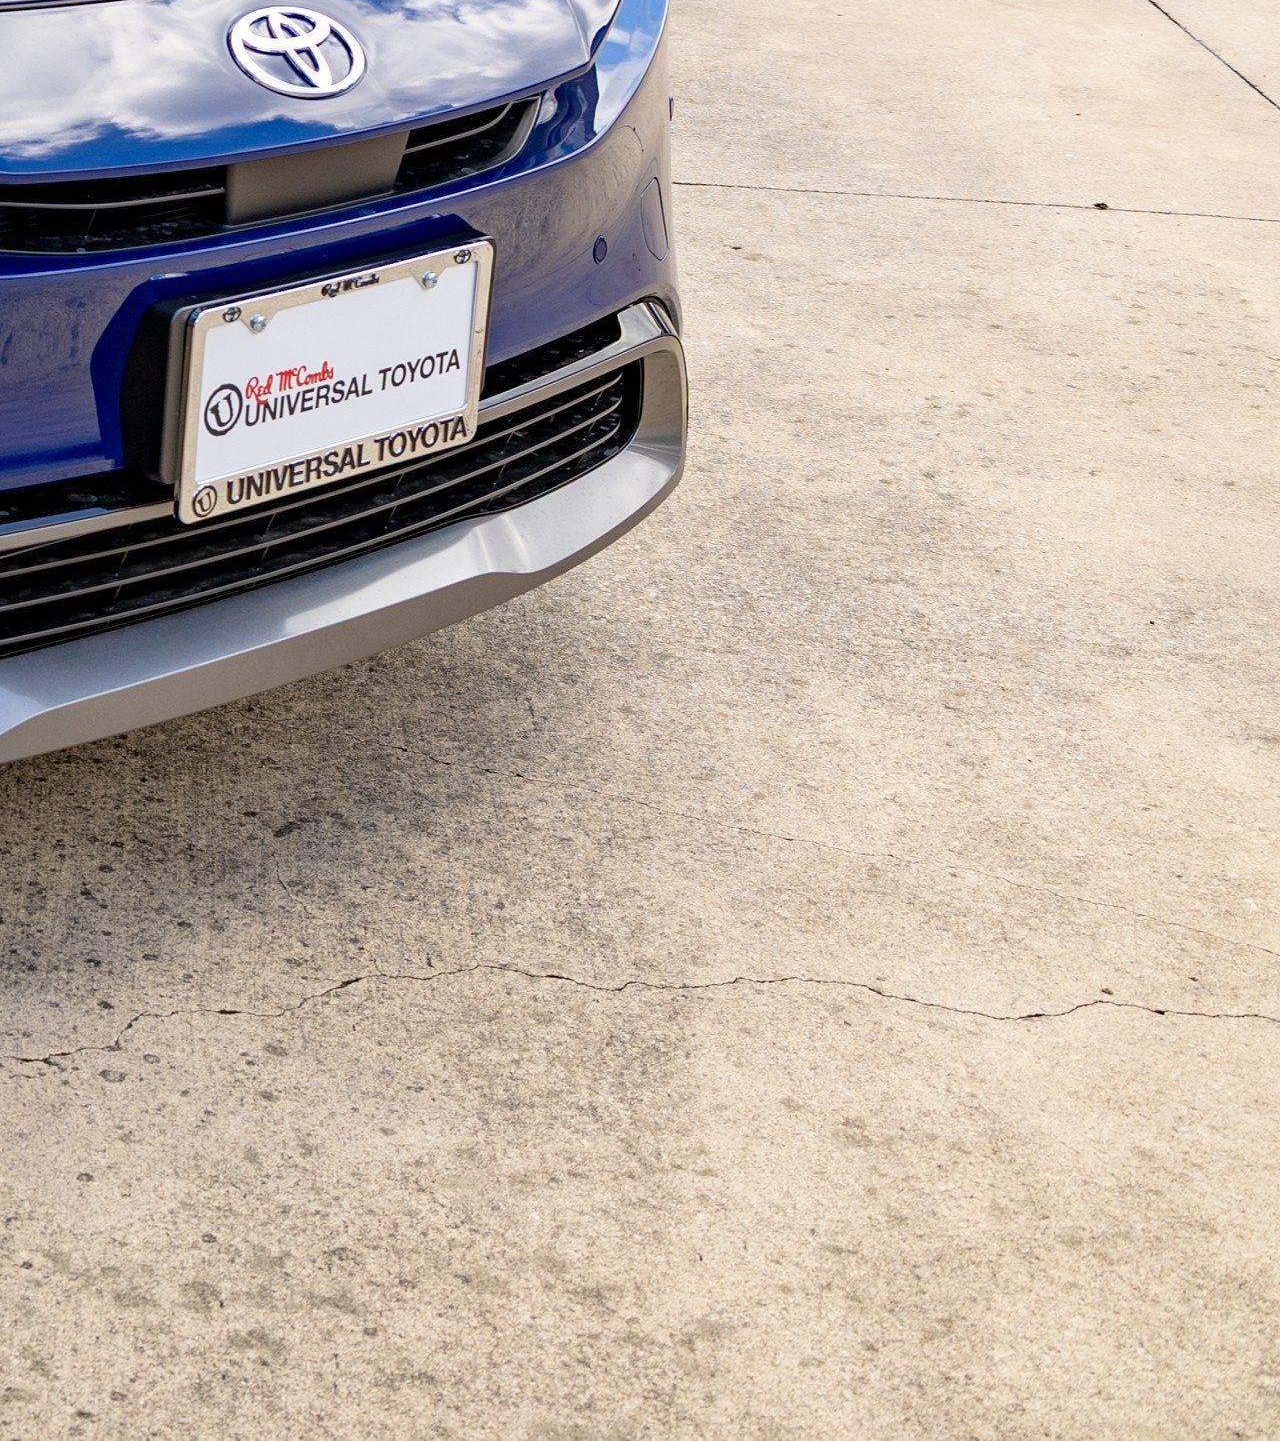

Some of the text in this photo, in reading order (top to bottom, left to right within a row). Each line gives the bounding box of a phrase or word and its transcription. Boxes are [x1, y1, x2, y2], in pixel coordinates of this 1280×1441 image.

[245, 375, 373, 427] UNIVERSAL
[378, 349, 461, 391] TOYOTA
[246, 372, 274, 406] Red
[227, 444, 371, 504] UNIVERSAL
[374, 416, 468, 462] TOYOTA
